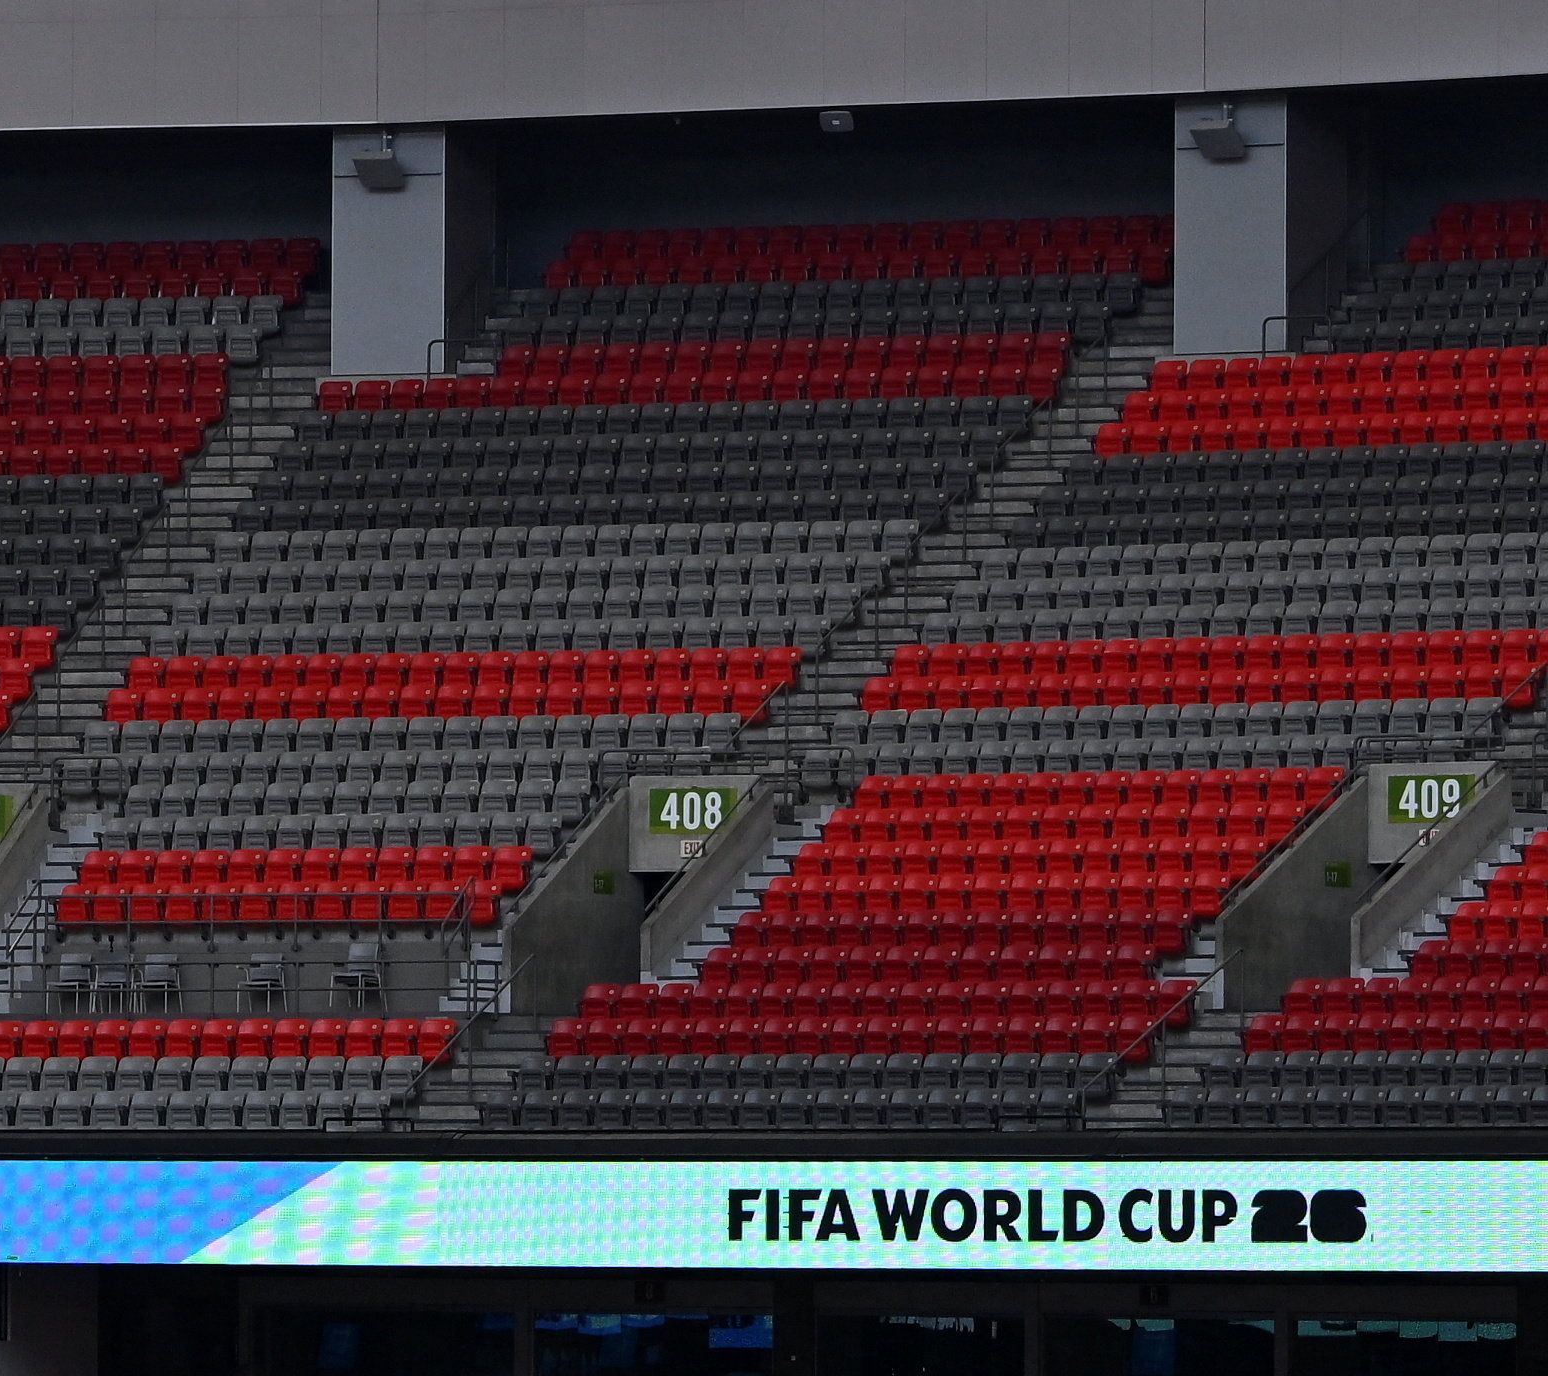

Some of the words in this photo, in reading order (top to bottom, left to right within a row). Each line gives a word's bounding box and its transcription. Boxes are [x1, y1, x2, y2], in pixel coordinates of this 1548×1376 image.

[661, 792, 721, 829] 408
[1400, 779, 1459, 818] 409
[728, 1189, 860, 1241] FIFA
[872, 1189, 1104, 1242] WORLD
[1119, 1189, 1237, 1242] CUP
[1251, 1190, 1366, 1243] 26
